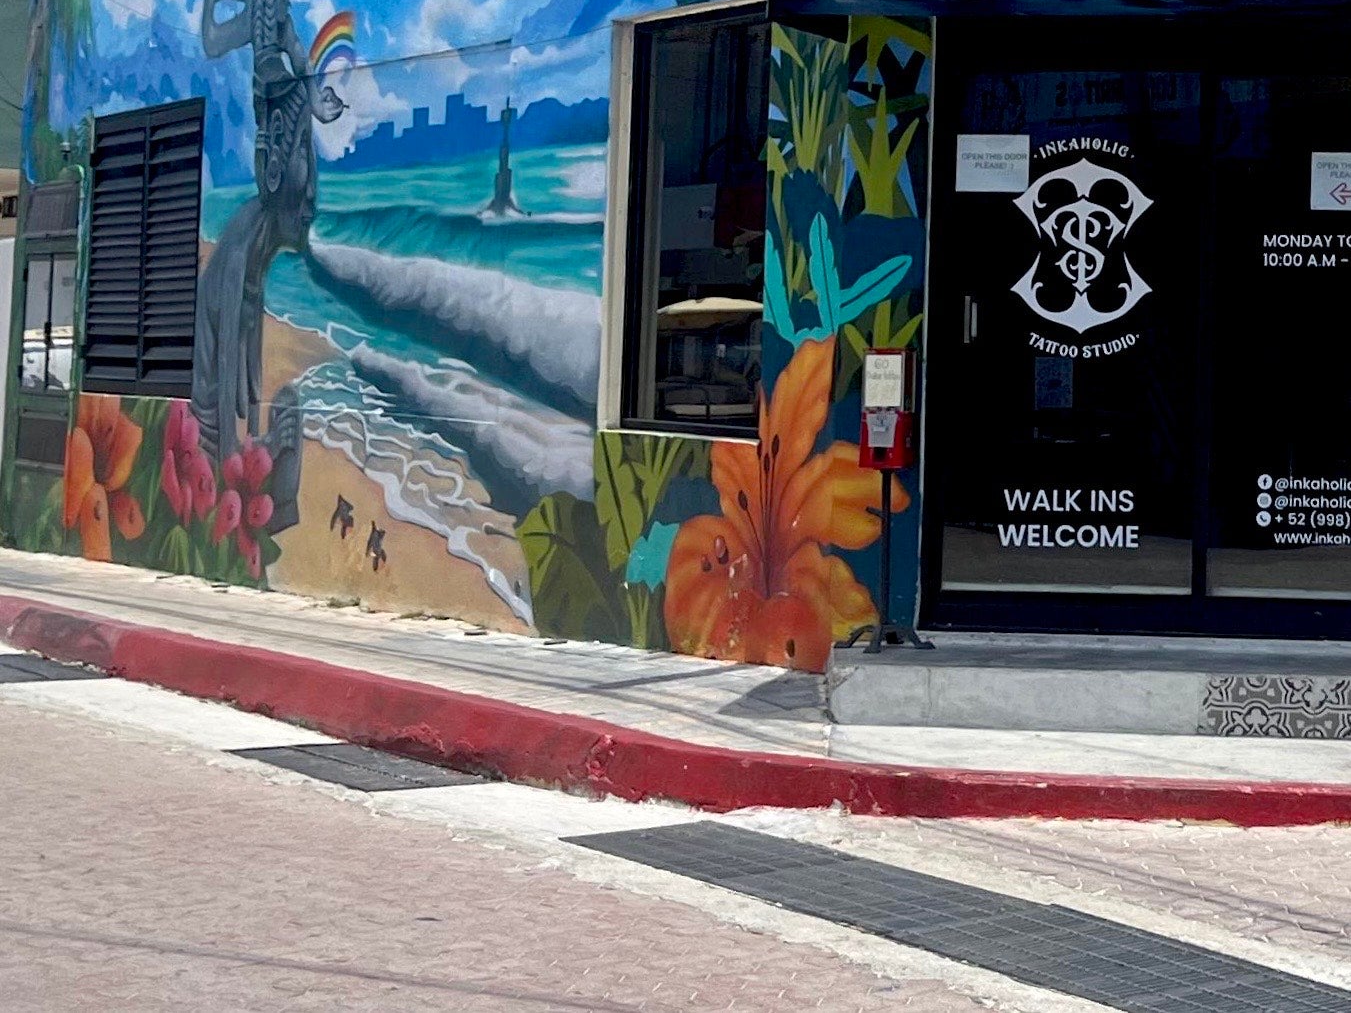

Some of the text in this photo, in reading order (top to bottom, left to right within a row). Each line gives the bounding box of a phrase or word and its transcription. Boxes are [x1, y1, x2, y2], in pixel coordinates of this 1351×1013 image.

[961, 153, 985, 161] OPEN
[1003, 153, 1028, 161] DOOR
[1038, 137, 1130, 159] INKAHOLIC
[1316, 162, 1339, 170] OPEN
[1263, 234, 1333, 247] MONDAY
[1263, 252, 1303, 267] 10:00
[1307, 253, 1336, 267] A.M
[1028, 332, 1136, 359] TATTOO STUDIO
[1003, 488, 1135, 513] WALK INS
[1288, 512, 1306, 525] 52
[1310, 510, 1351, 529] (998)
[997, 524, 1140, 548] WELCOME
